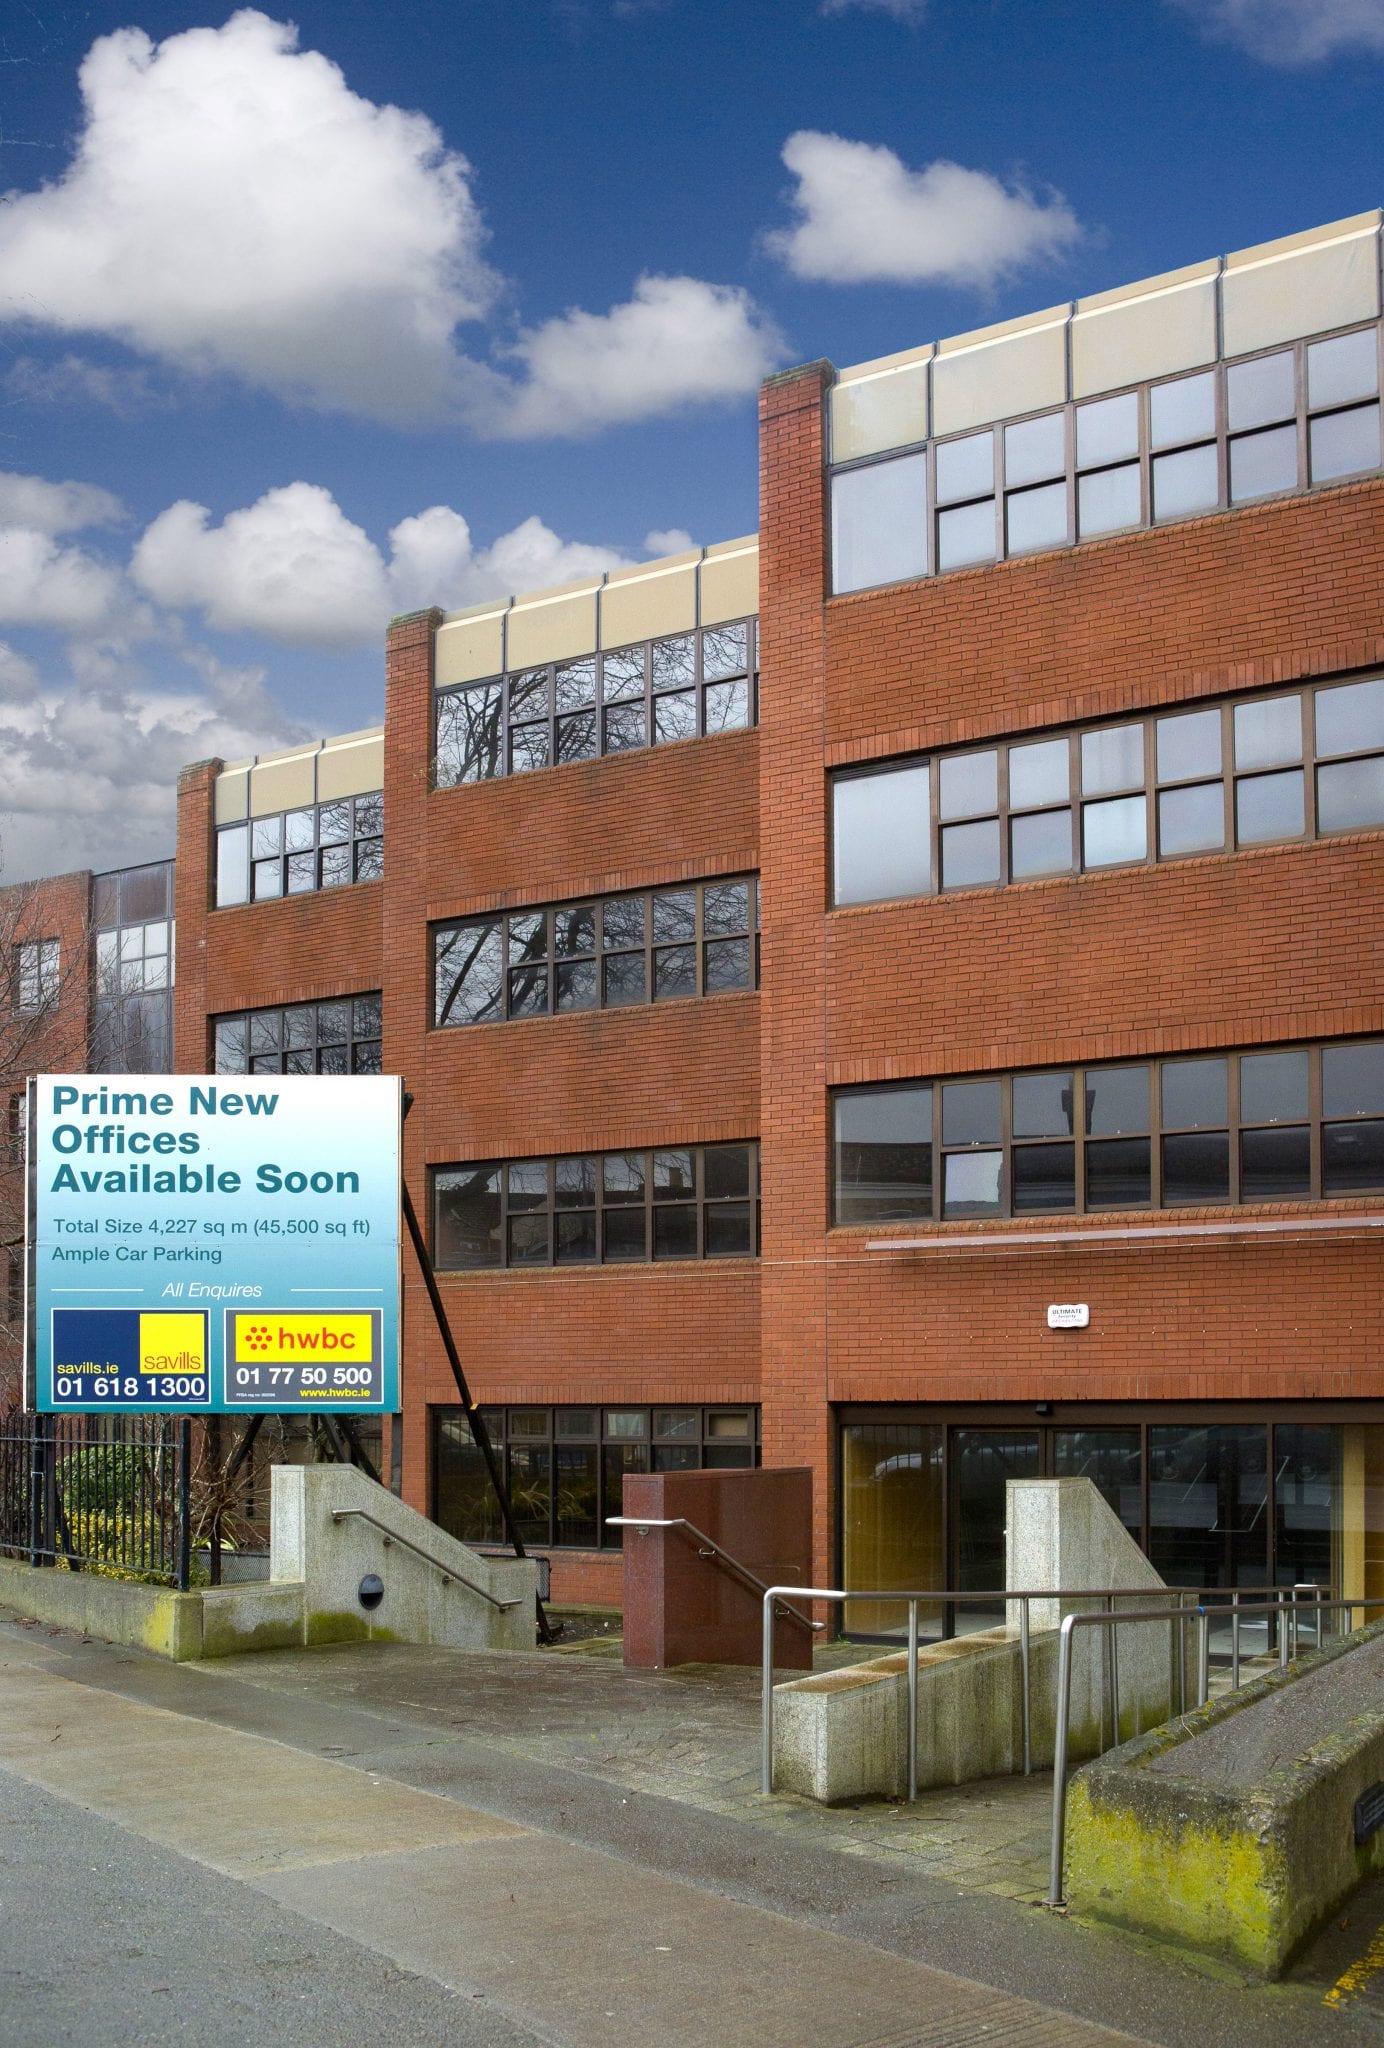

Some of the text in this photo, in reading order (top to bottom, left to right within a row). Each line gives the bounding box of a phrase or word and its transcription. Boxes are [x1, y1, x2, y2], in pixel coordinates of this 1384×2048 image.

[54, 1086, 279, 1115] Prime New
[52, 1125, 200, 1154] Offices
[51, 1164, 359, 1193] Available Soon
[54, 1219, 369, 1237] Total Size 4,227 sq m (45,500 sq ft)
[52, 1246, 221, 1264] Ample Car Parking
[162, 1282, 262, 1300] All Enquires
[279, 1327, 355, 1349] hwbc
[57, 1362, 118, 1374] savills.ie
[144, 1352, 200, 1369] savills
[237, 1368, 372, 1384] 01 77 50 500
[57, 1378, 205, 1396] 01 618 1300
[300, 1388, 370, 1397] www.hwbc.ie
